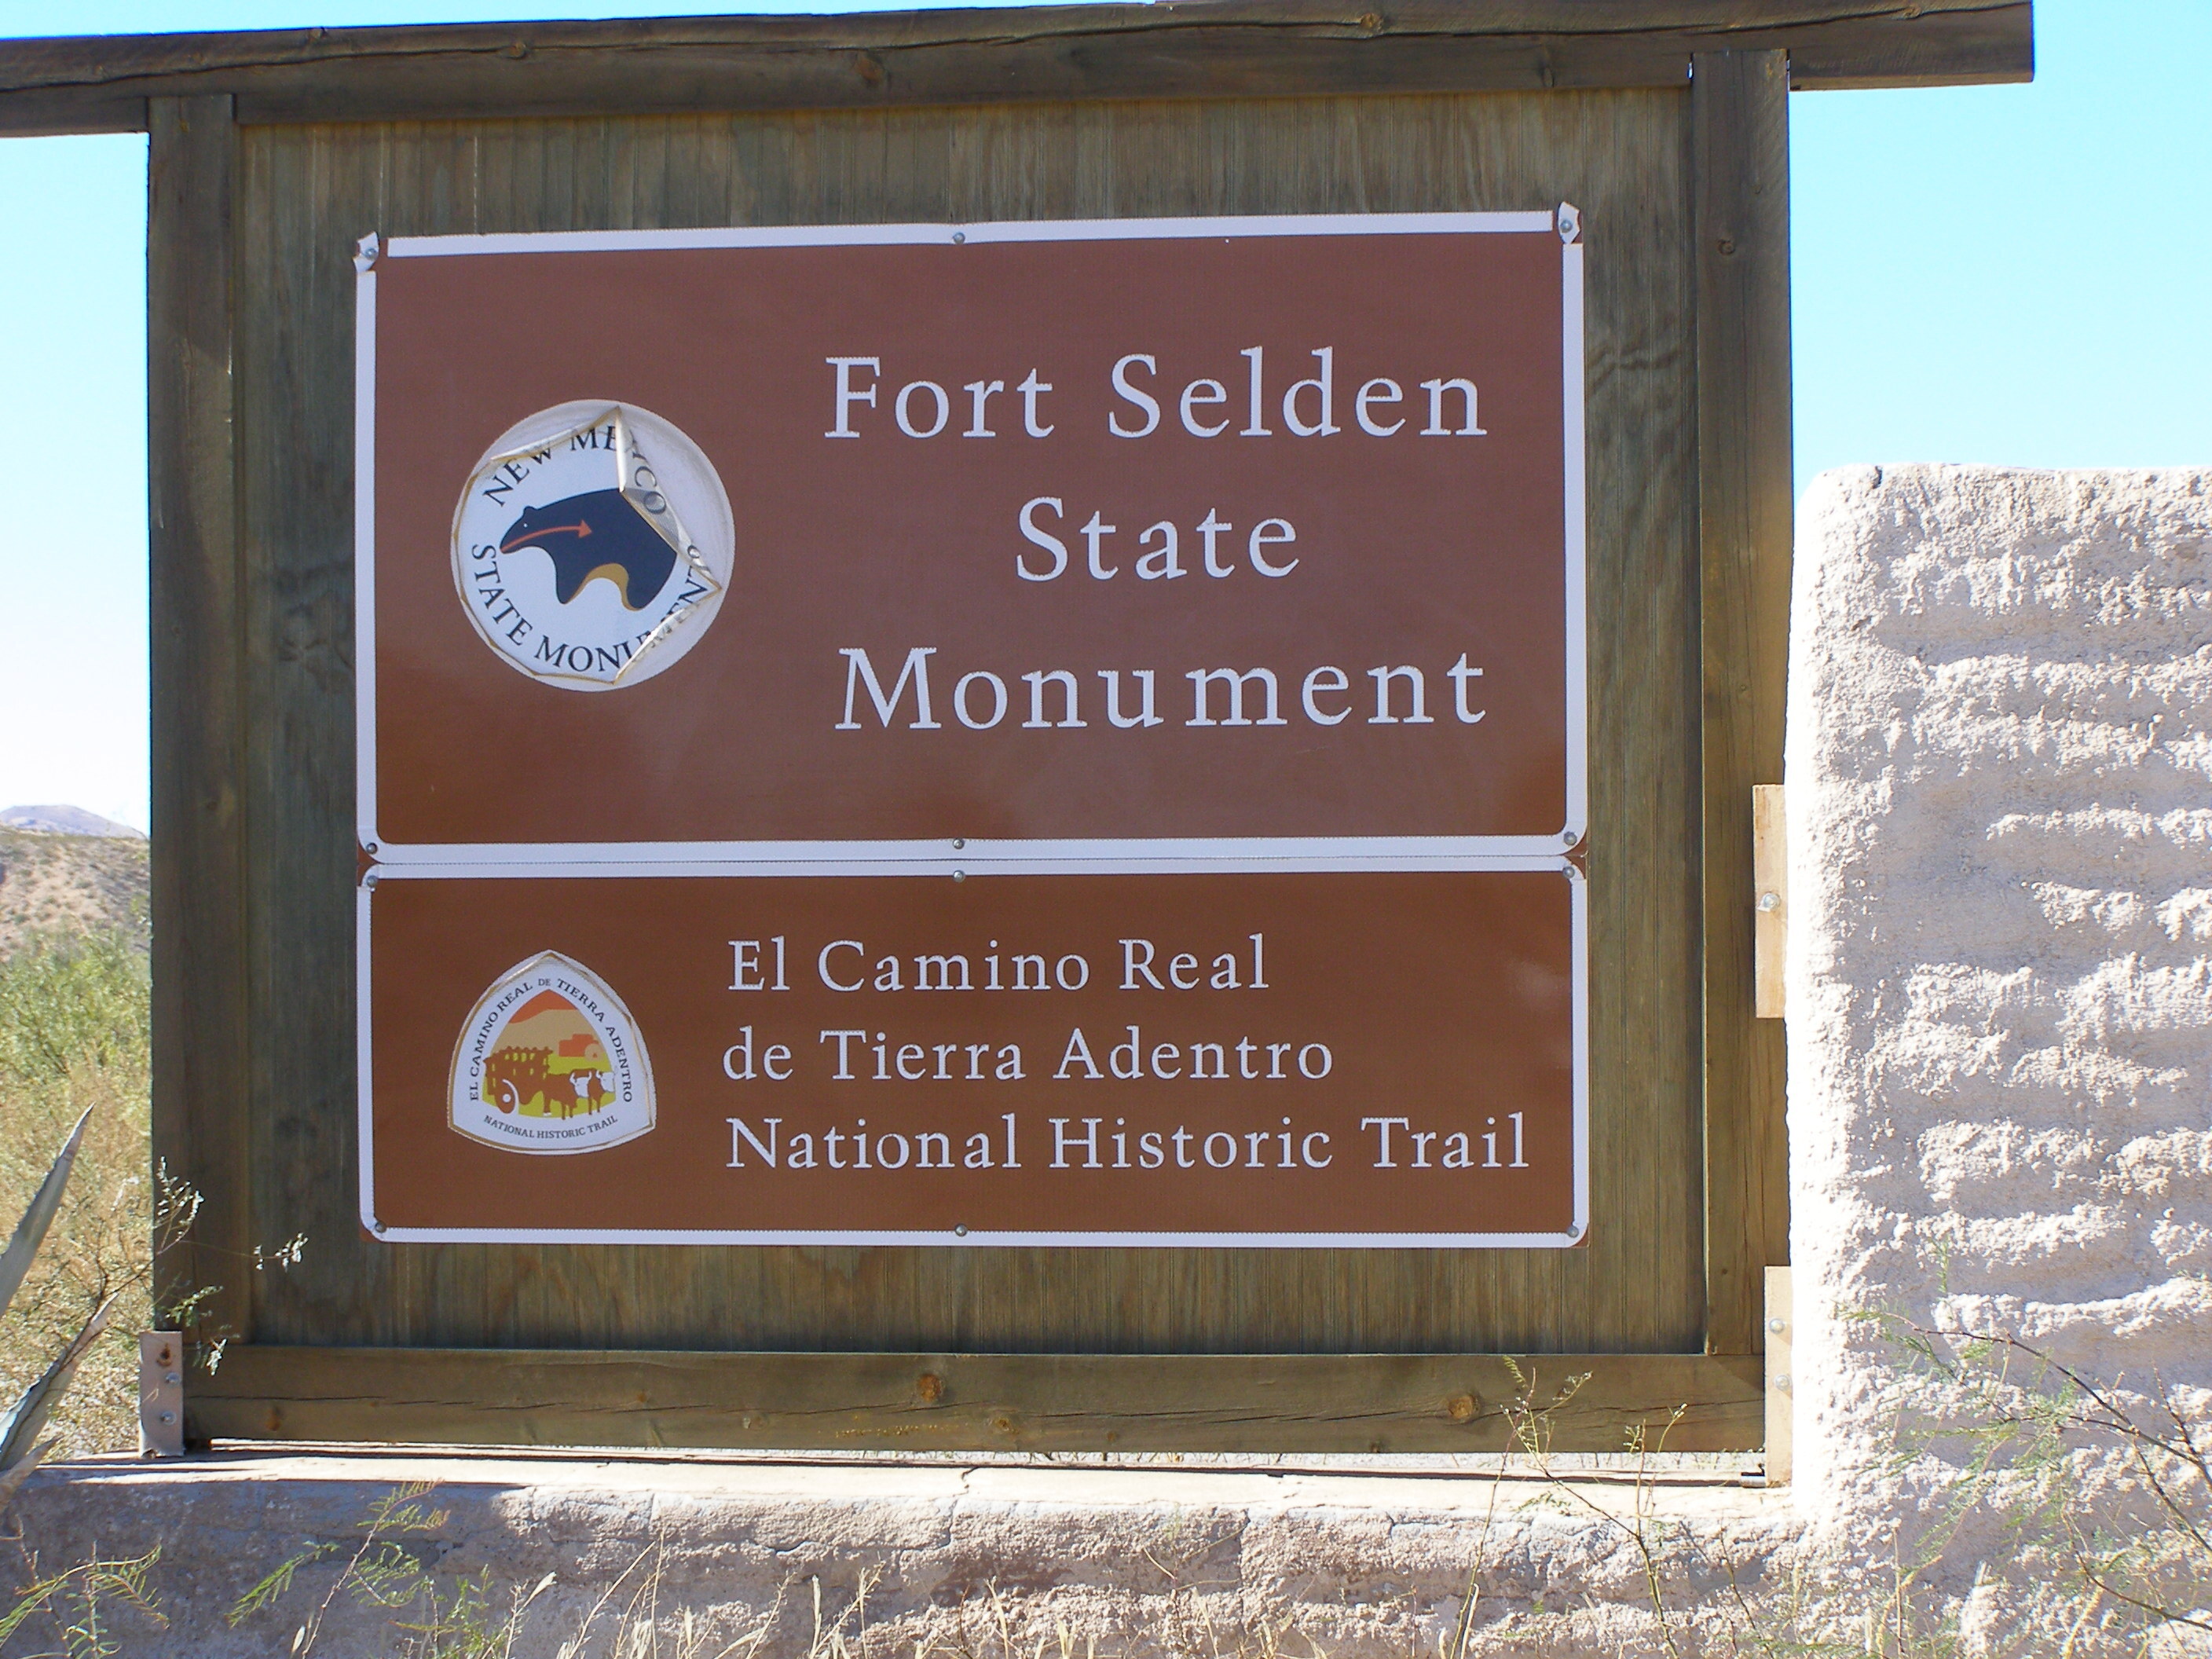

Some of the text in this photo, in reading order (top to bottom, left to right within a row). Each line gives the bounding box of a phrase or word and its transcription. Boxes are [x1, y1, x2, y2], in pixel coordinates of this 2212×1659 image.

[823, 345, 1489, 439] Fort Selden
[482, 447, 551, 507] NEW
[1016, 495, 1301, 582] State
[471, 544, 533, 646] STATE
[833, 646, 1487, 731] Monument
[727, 932, 1270, 992] El Camino Real
[469, 977, 632, 1103] EL CAMINO REAL DE TIERRA ADENTRO
[722, 1024, 1333, 1081] de Tierra Adentro
[484, 1115, 618, 1140] NATIONAL HISTORIC TRAIL
[724, 1110, 1530, 1170] National Historic Trail
